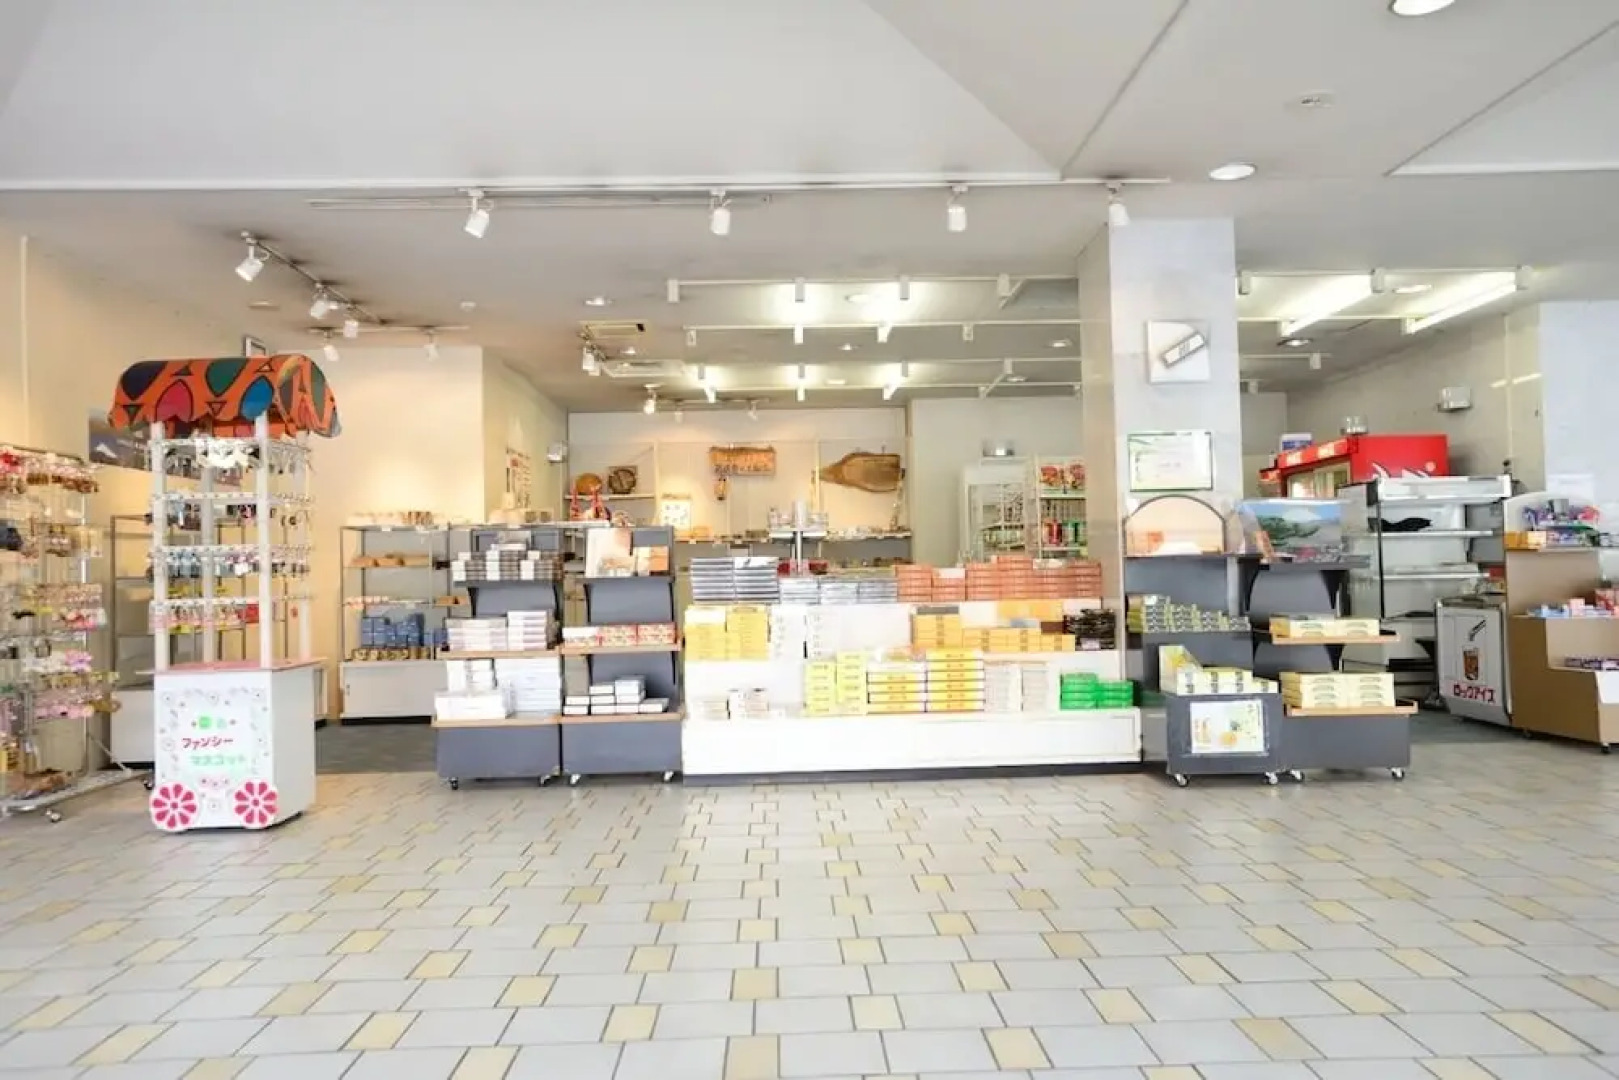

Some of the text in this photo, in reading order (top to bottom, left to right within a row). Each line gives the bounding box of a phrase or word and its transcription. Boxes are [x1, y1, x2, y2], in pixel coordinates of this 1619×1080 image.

[182, 736, 233, 749] ファンシー
